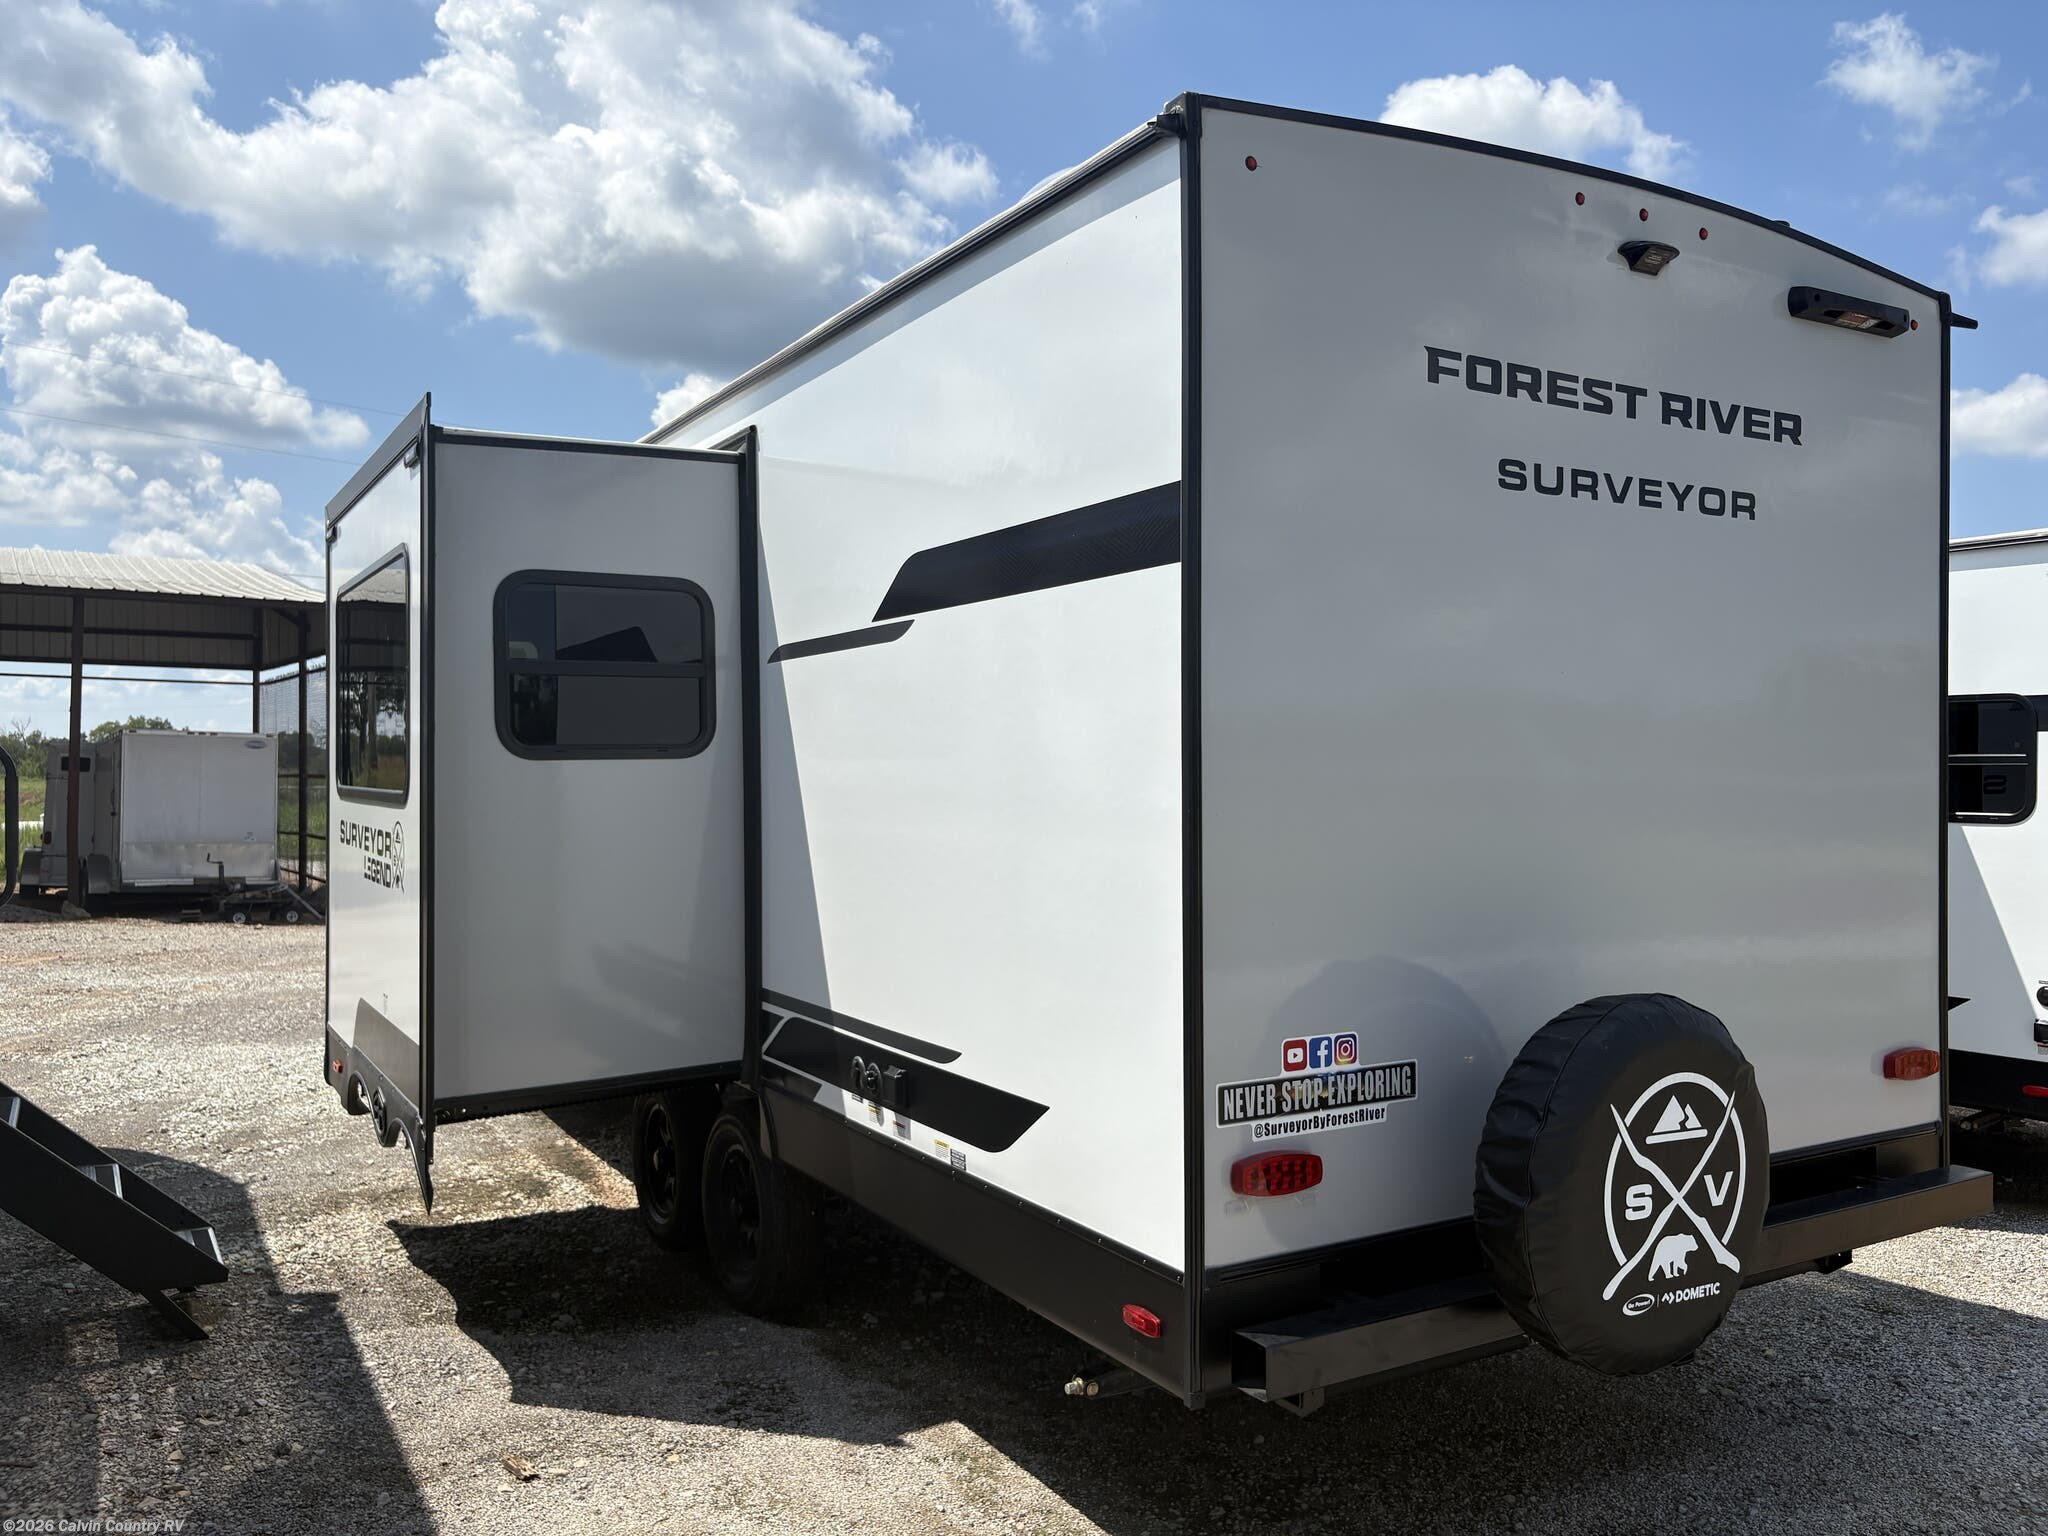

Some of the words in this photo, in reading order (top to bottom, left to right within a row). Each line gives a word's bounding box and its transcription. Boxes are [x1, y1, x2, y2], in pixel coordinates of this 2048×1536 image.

[1424, 345, 1648, 420] FOREST
[1658, 391, 1803, 446] RIVER
[1498, 458, 1756, 521] SURVEYOR
[340, 819, 392, 860] SURVEYOR
[364, 856, 392, 889] LEGEND
[1223, 1083, 1276, 1121] NEVER
[1281, 1077, 1324, 1113] STOP
[1328, 1065, 1412, 1105] EXPLORING
[1254, 1107, 1386, 1139] @SurveyorByForestRiver
[1625, 1183, 1653, 1221] S
[1703, 1170, 1734, 1207] V
[1675, 1282, 1720, 1303] DOMETIC
